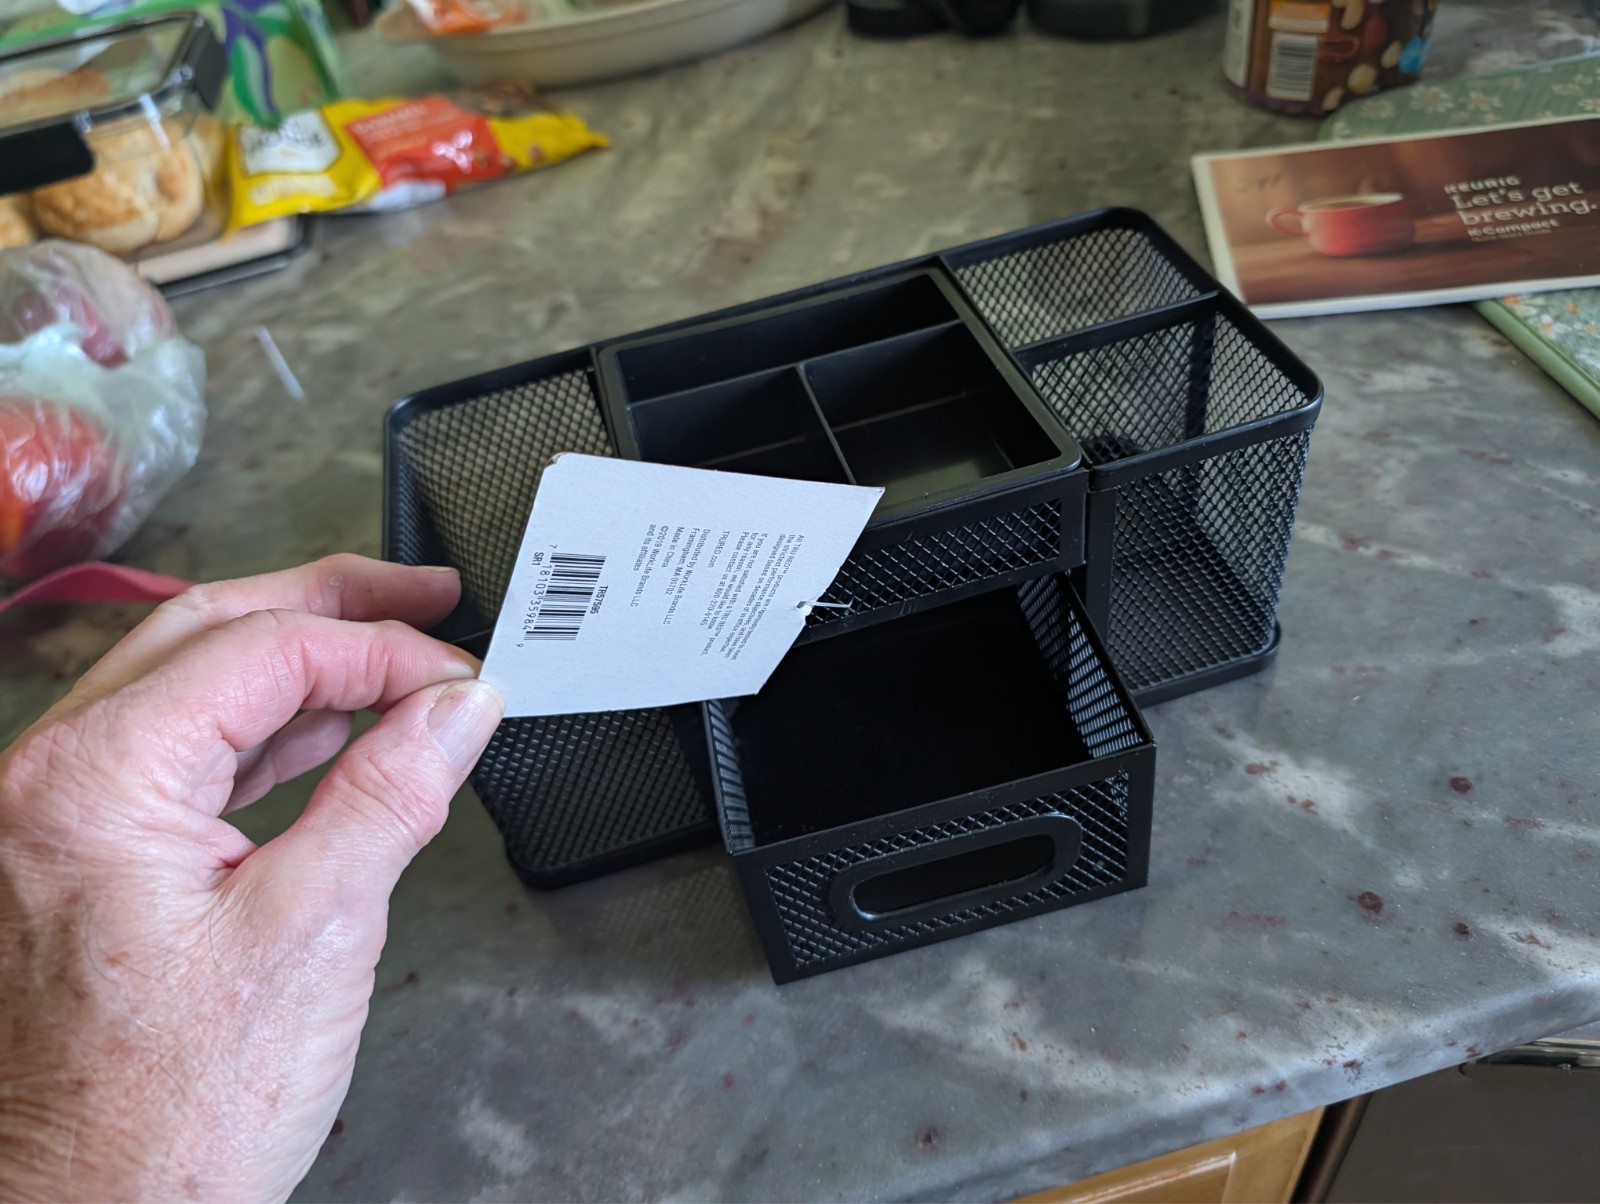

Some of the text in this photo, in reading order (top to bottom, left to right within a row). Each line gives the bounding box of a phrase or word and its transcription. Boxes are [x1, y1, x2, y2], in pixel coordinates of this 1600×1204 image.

[1444, 175, 1521, 194] KEURIG
[1451, 182, 1584, 209] Let's get
[1458, 200, 1598, 225] brewing.
[646, 524, 657, 536] and
[671, 527, 685, 543] Made
[690, 529, 711, 561] Distributed
[707, 530, 730, 568] TRURED.com
[734, 532, 749, 550] Please
[742, 541, 753, 552] any
[754, 538, 765, 548] you
[768, 534, 786, 558] designed
[789, 543, 801, 554] TRU
[531, 552, 544, 565] SR1
[632, 546, 649, 571] affiliates
[661, 551, 675, 567] China
[664, 528, 700, 595] Framingham, MA 01702
[724, 552, 739, 572] contact
[733, 553, 748, 573] reason,
[750, 549, 759, 558] are
[774, 545, 790, 567] strictest
[630, 526, 669, 607] ©2019 WorkLife Brands LLC
[760, 560, 774, 576] based
[533, 564, 552, 595] 18103
[676, 570, 693, 594] WorkLife
[734, 570, 750, 592] satisfied
[756, 568, 779, 601] performance
[766, 575, 784, 597] products
[721, 584, 735, 599] would
[728, 593, 738, 604] with
[745, 585, 761, 606] decades
[667, 595, 682, 613] Brands
[716, 600, 727, 609] like
[521, 599, 543, 630] 35984
[662, 614, 673, 624] LLC
[720, 610, 732, 620] TRU
